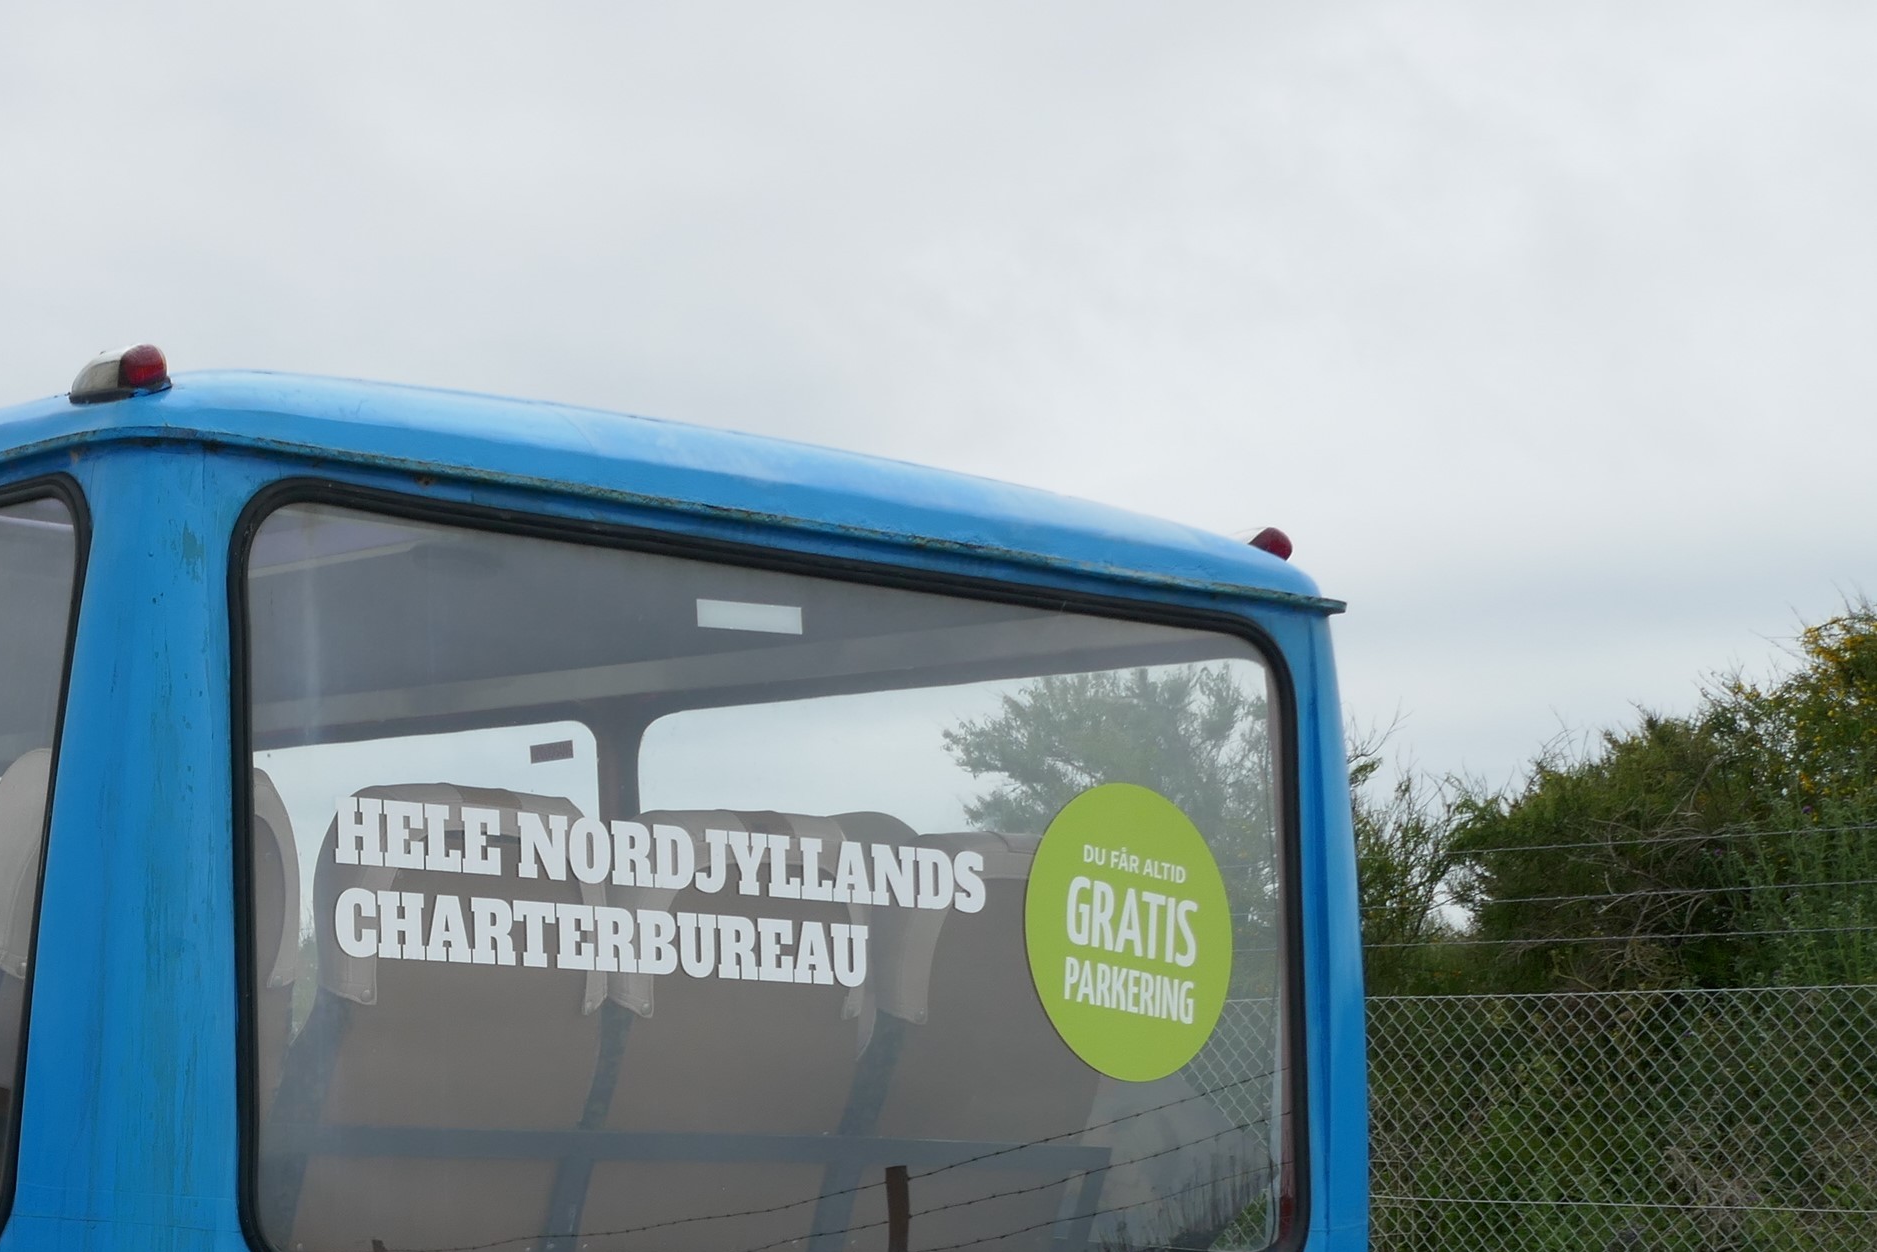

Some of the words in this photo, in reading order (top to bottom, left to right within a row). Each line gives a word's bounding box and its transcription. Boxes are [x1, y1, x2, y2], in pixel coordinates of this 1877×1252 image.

[335, 797, 502, 877] HELE
[516, 812, 987, 914] NORDJYLLANDS
[1083, 844, 1106, 866] DU
[1110, 847, 1140, 874] FÅR
[1142, 858, 1187, 884] ALTID
[334, 887, 869, 988] CHARTERBUREAU
[1066, 875, 1199, 968] GRATIS
[1063, 956, 1196, 1025] PARKERING
